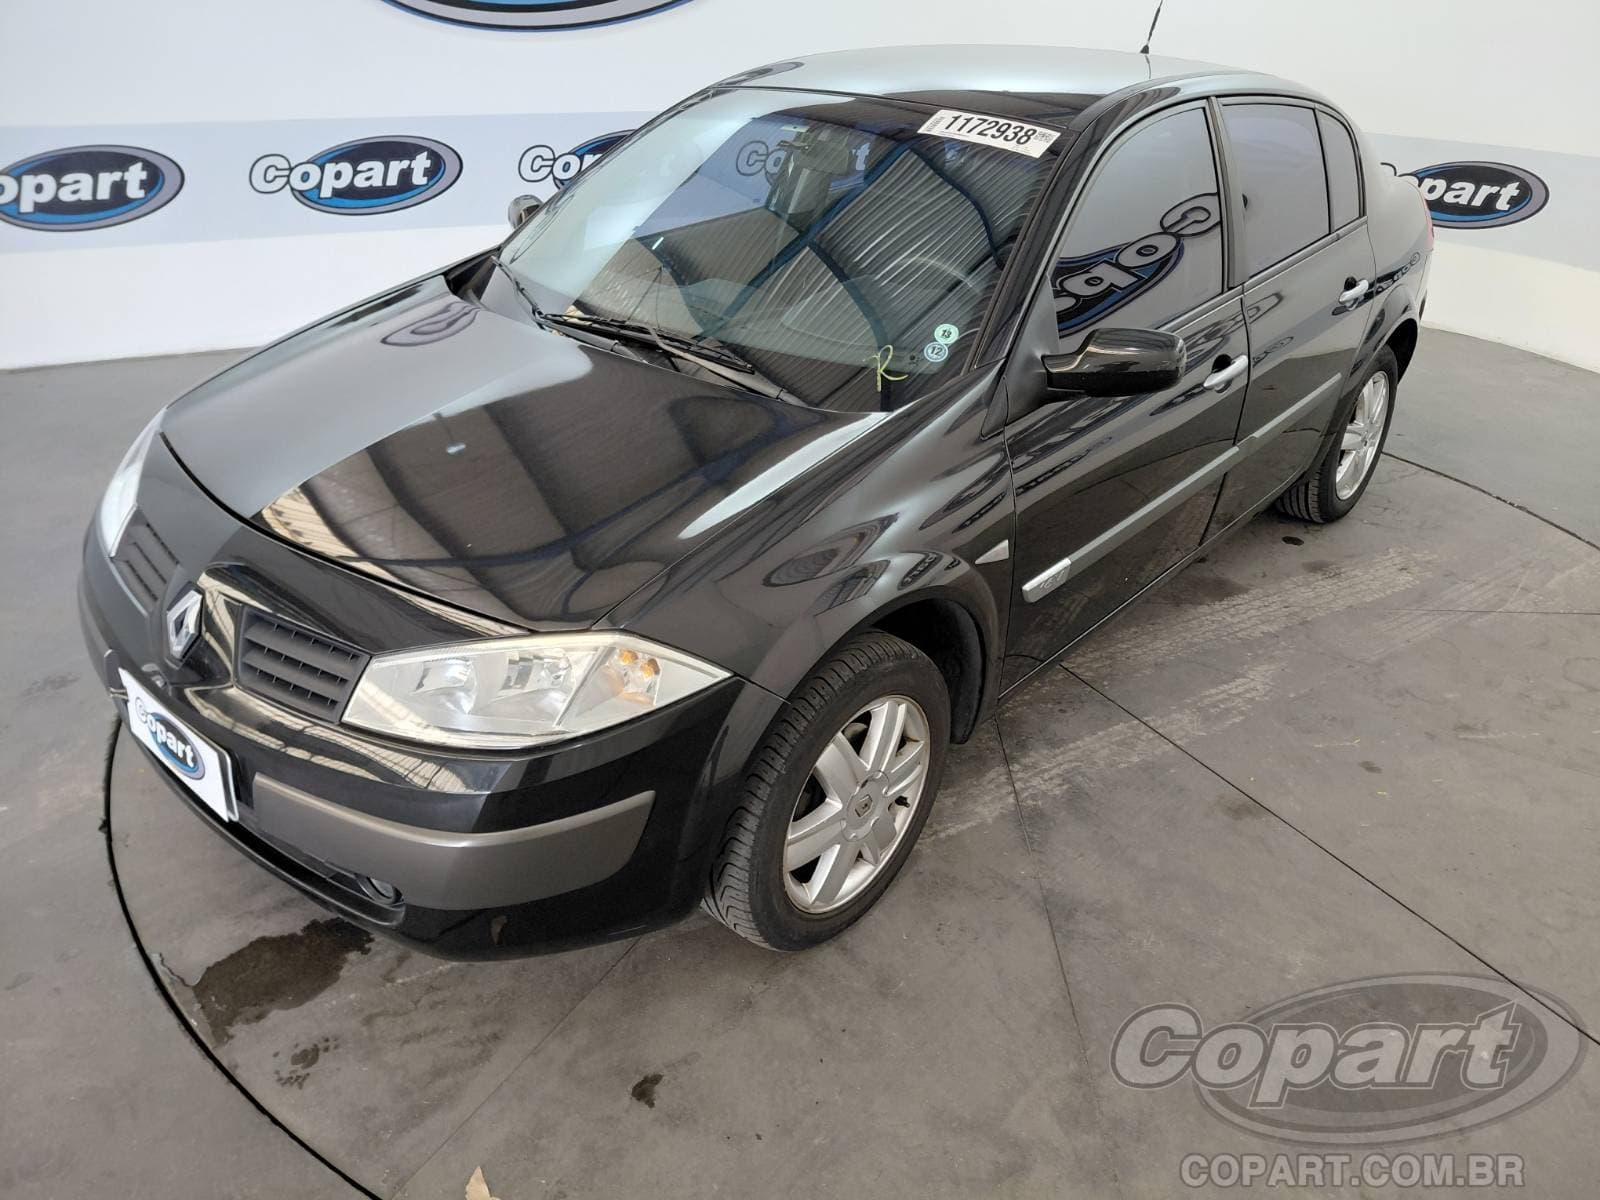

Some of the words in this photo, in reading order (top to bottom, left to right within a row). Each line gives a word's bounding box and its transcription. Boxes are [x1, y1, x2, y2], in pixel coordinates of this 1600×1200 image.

[945, 114, 1037, 146] 1172938
[0, 162, 148, 214] opart
[248, 151, 432, 199] Copart
[1380, 162, 1521, 211] part
[134, 696, 195, 769] Copart
